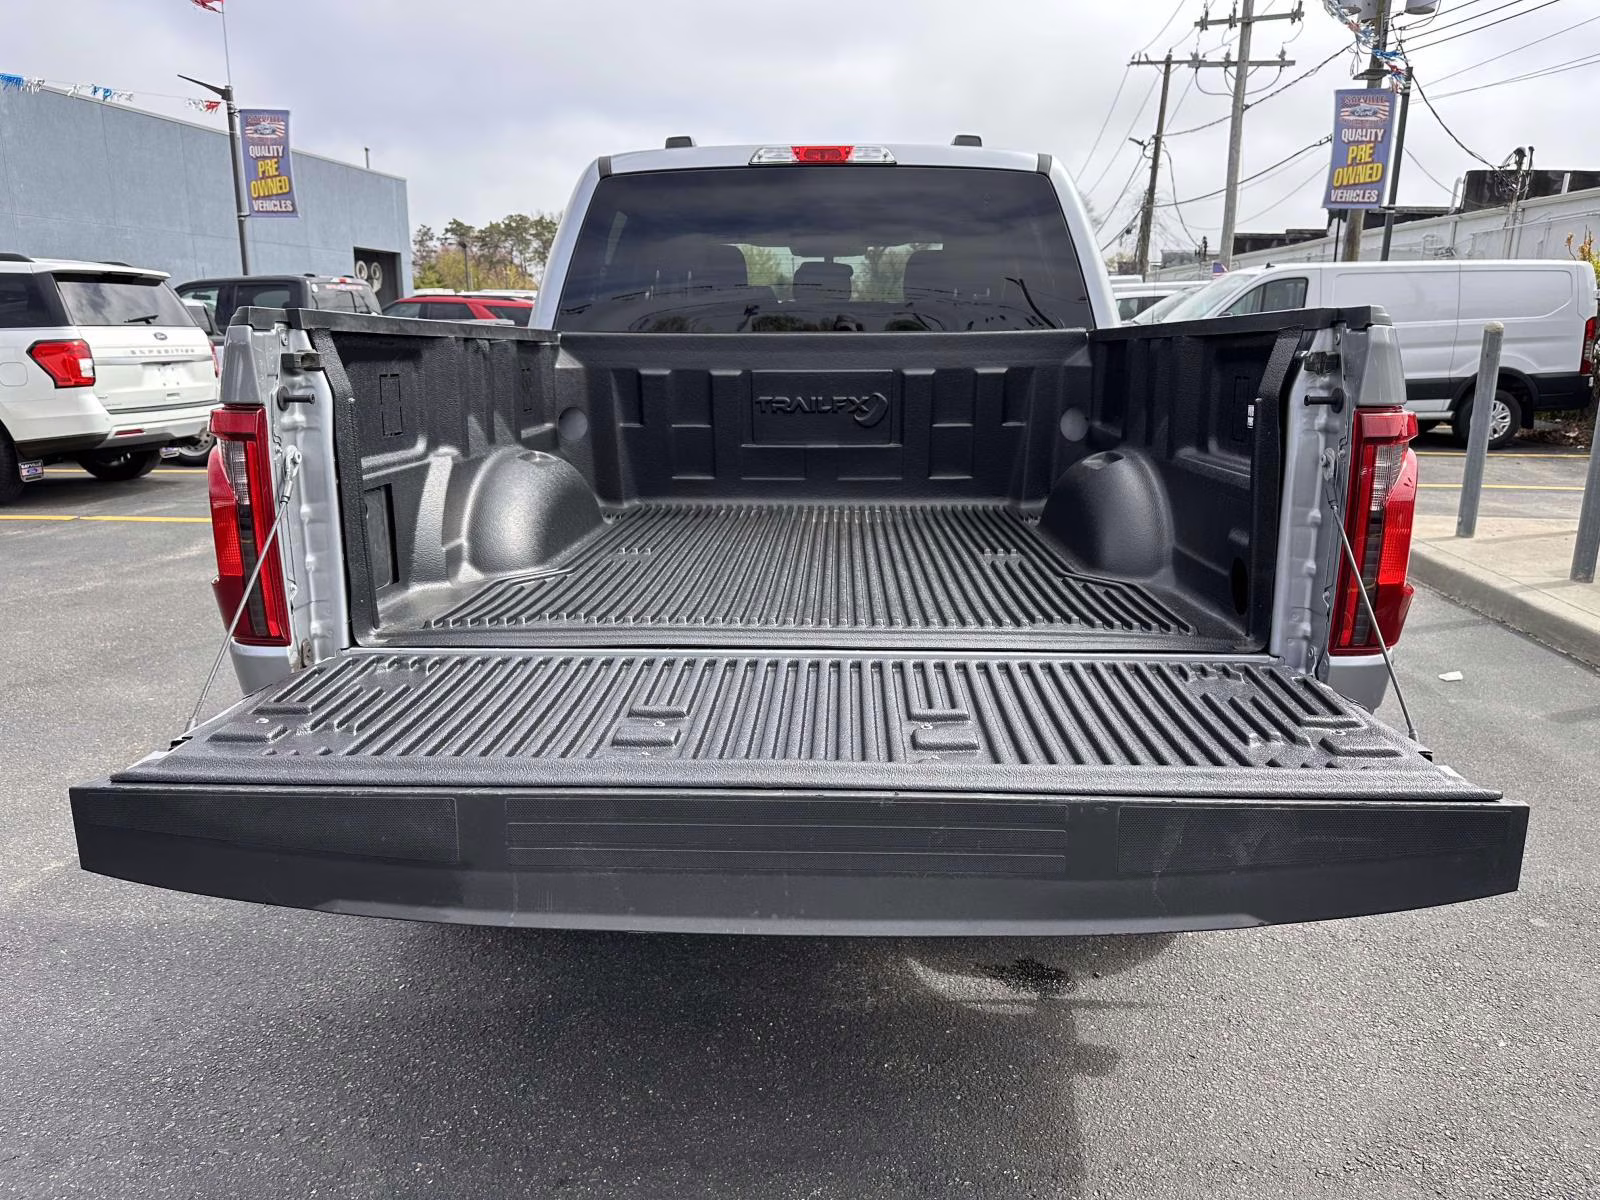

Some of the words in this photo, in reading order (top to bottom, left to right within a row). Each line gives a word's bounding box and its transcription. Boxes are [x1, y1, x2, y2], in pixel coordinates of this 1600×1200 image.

[1341, 128, 1384, 142] QUALITY
[249, 145, 284, 158] QUALITY
[1348, 143, 1374, 165] PRE
[257, 158, 279, 177] PRE
[1333, 163, 1383, 187] OWNED
[250, 176, 289, 198] OWNED
[1330, 189, 1378, 203] VEHICLES
[252, 200, 293, 212] VEHICLES
